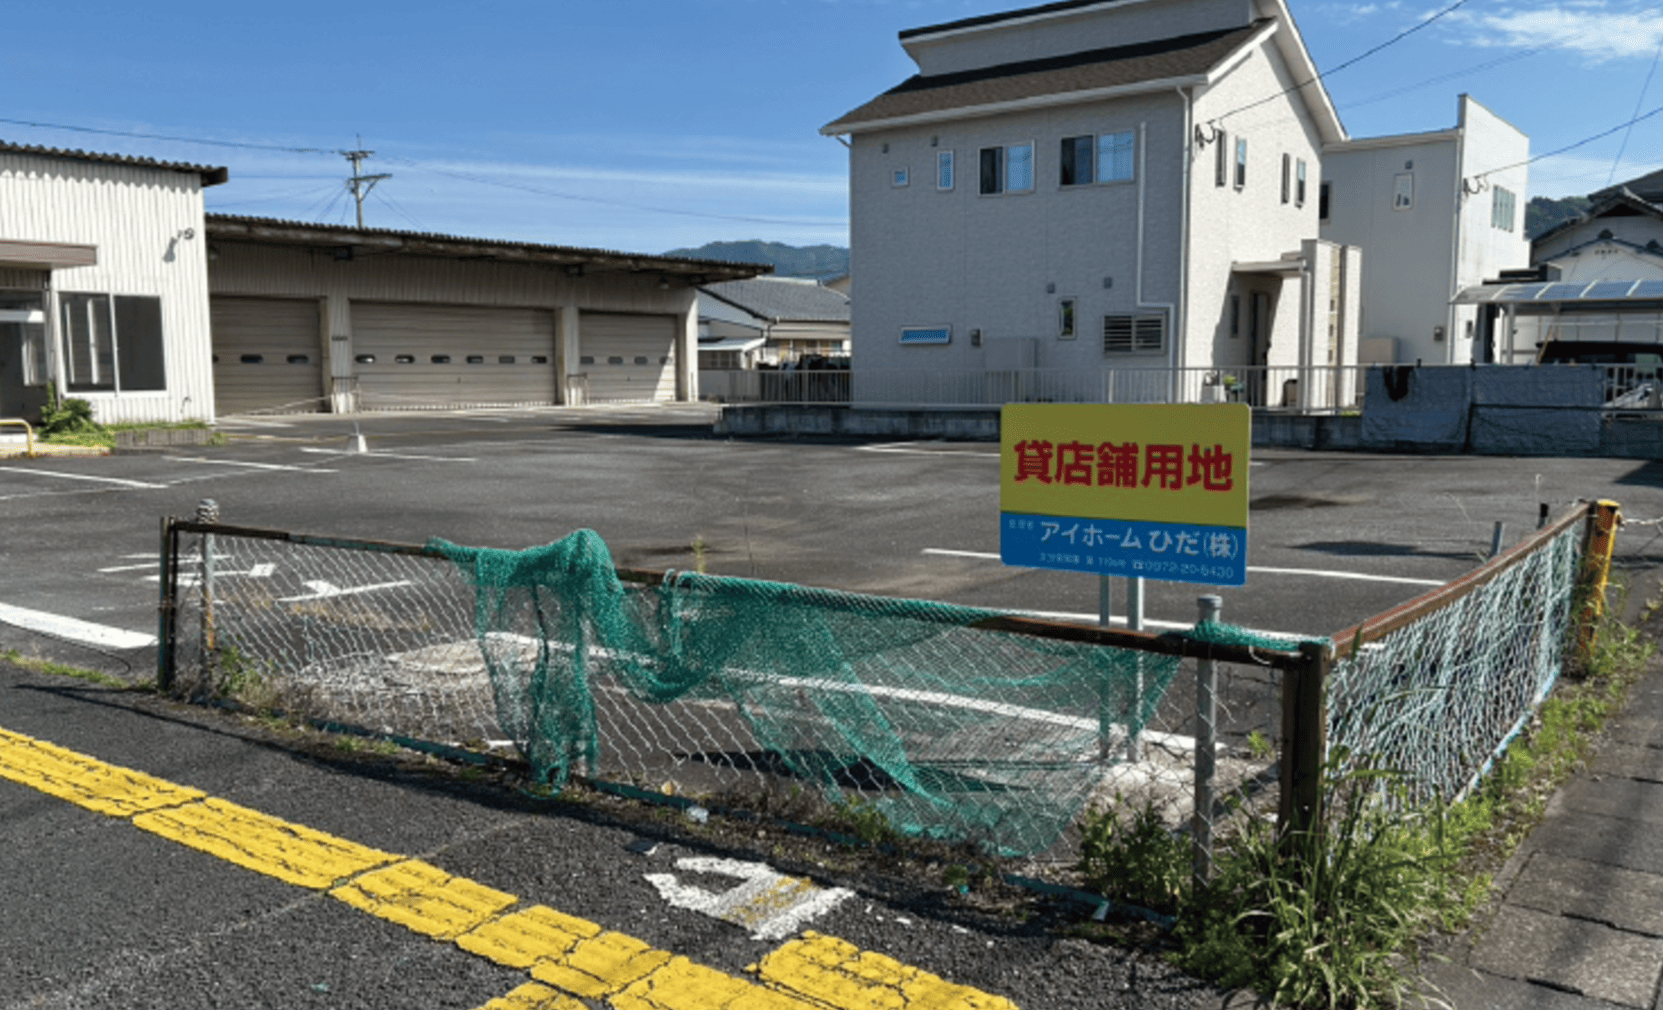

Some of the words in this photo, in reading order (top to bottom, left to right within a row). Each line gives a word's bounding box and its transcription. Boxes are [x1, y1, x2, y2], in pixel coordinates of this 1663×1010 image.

[1014, 440, 1233, 491] 貸店舗用地
[1040, 520, 1142, 549] アイホーム
